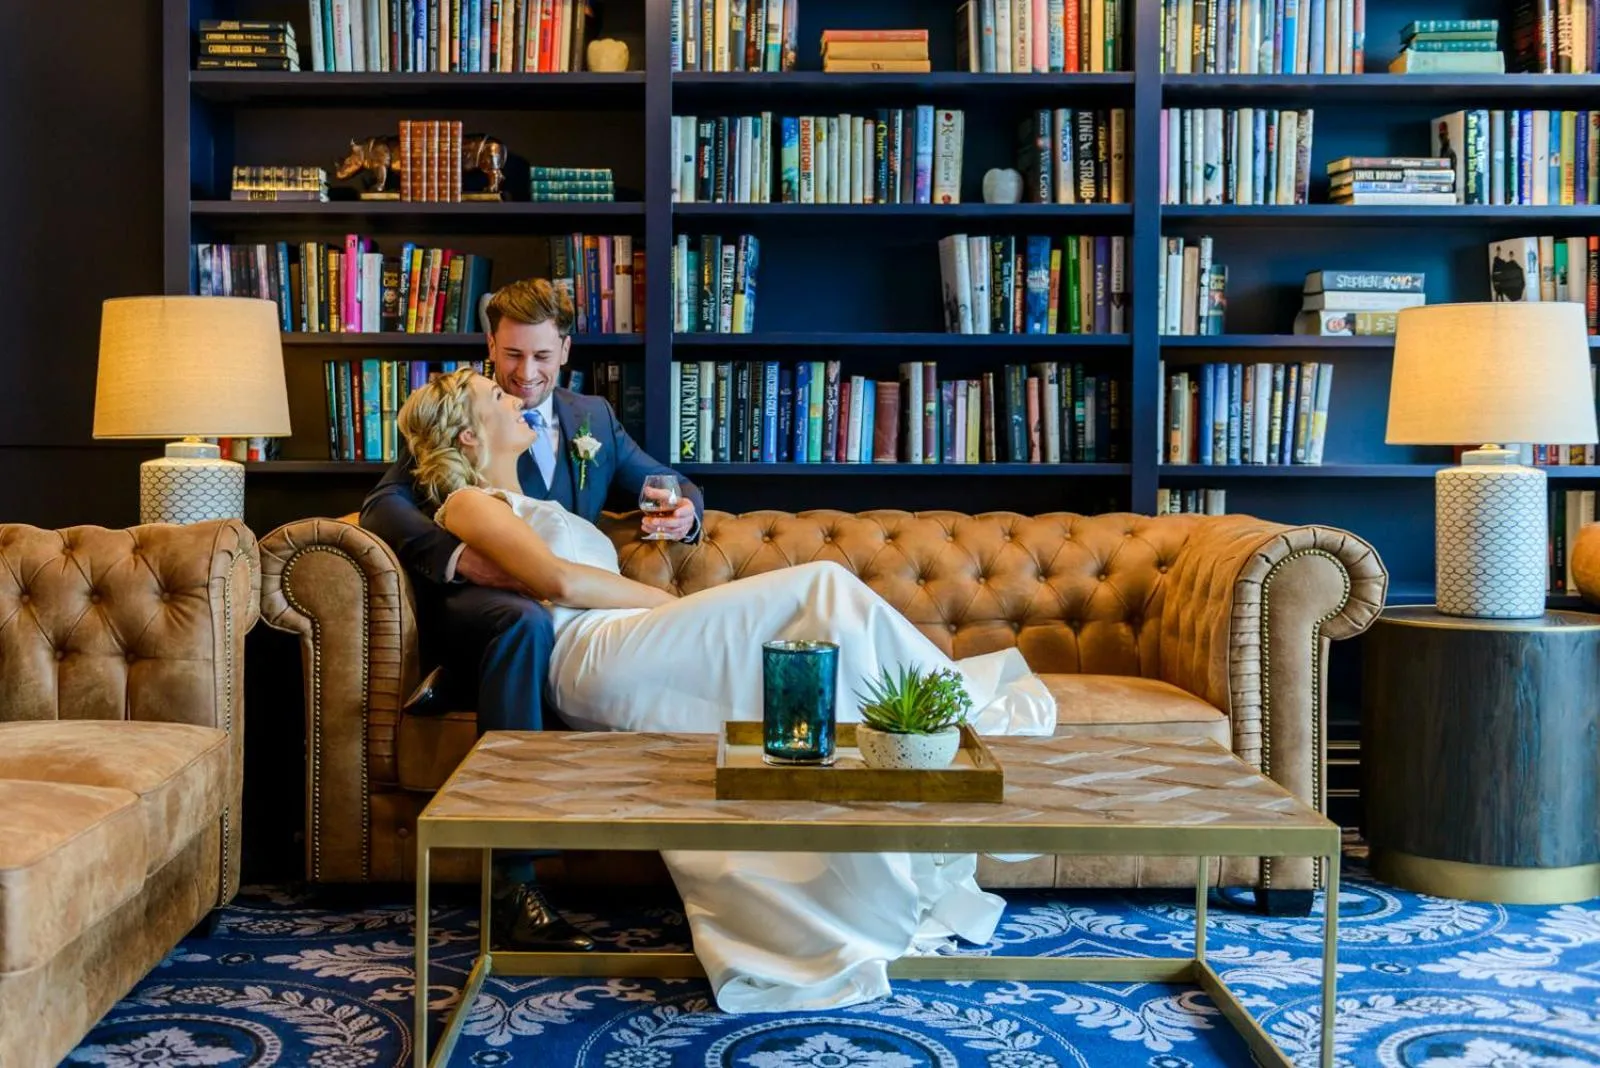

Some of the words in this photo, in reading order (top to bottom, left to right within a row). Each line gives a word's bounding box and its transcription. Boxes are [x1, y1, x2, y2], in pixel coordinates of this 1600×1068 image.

[1558, 14, 1573, 57] RICKY
[801, 120, 811, 171] DEIGHTON
[1078, 111, 1094, 142] KING
[1079, 159, 1095, 198] STRAUB
[1336, 275, 1377, 289] STEPHEN
[682, 375, 698, 415] FRENCH
[682, 417, 698, 442] KISS
